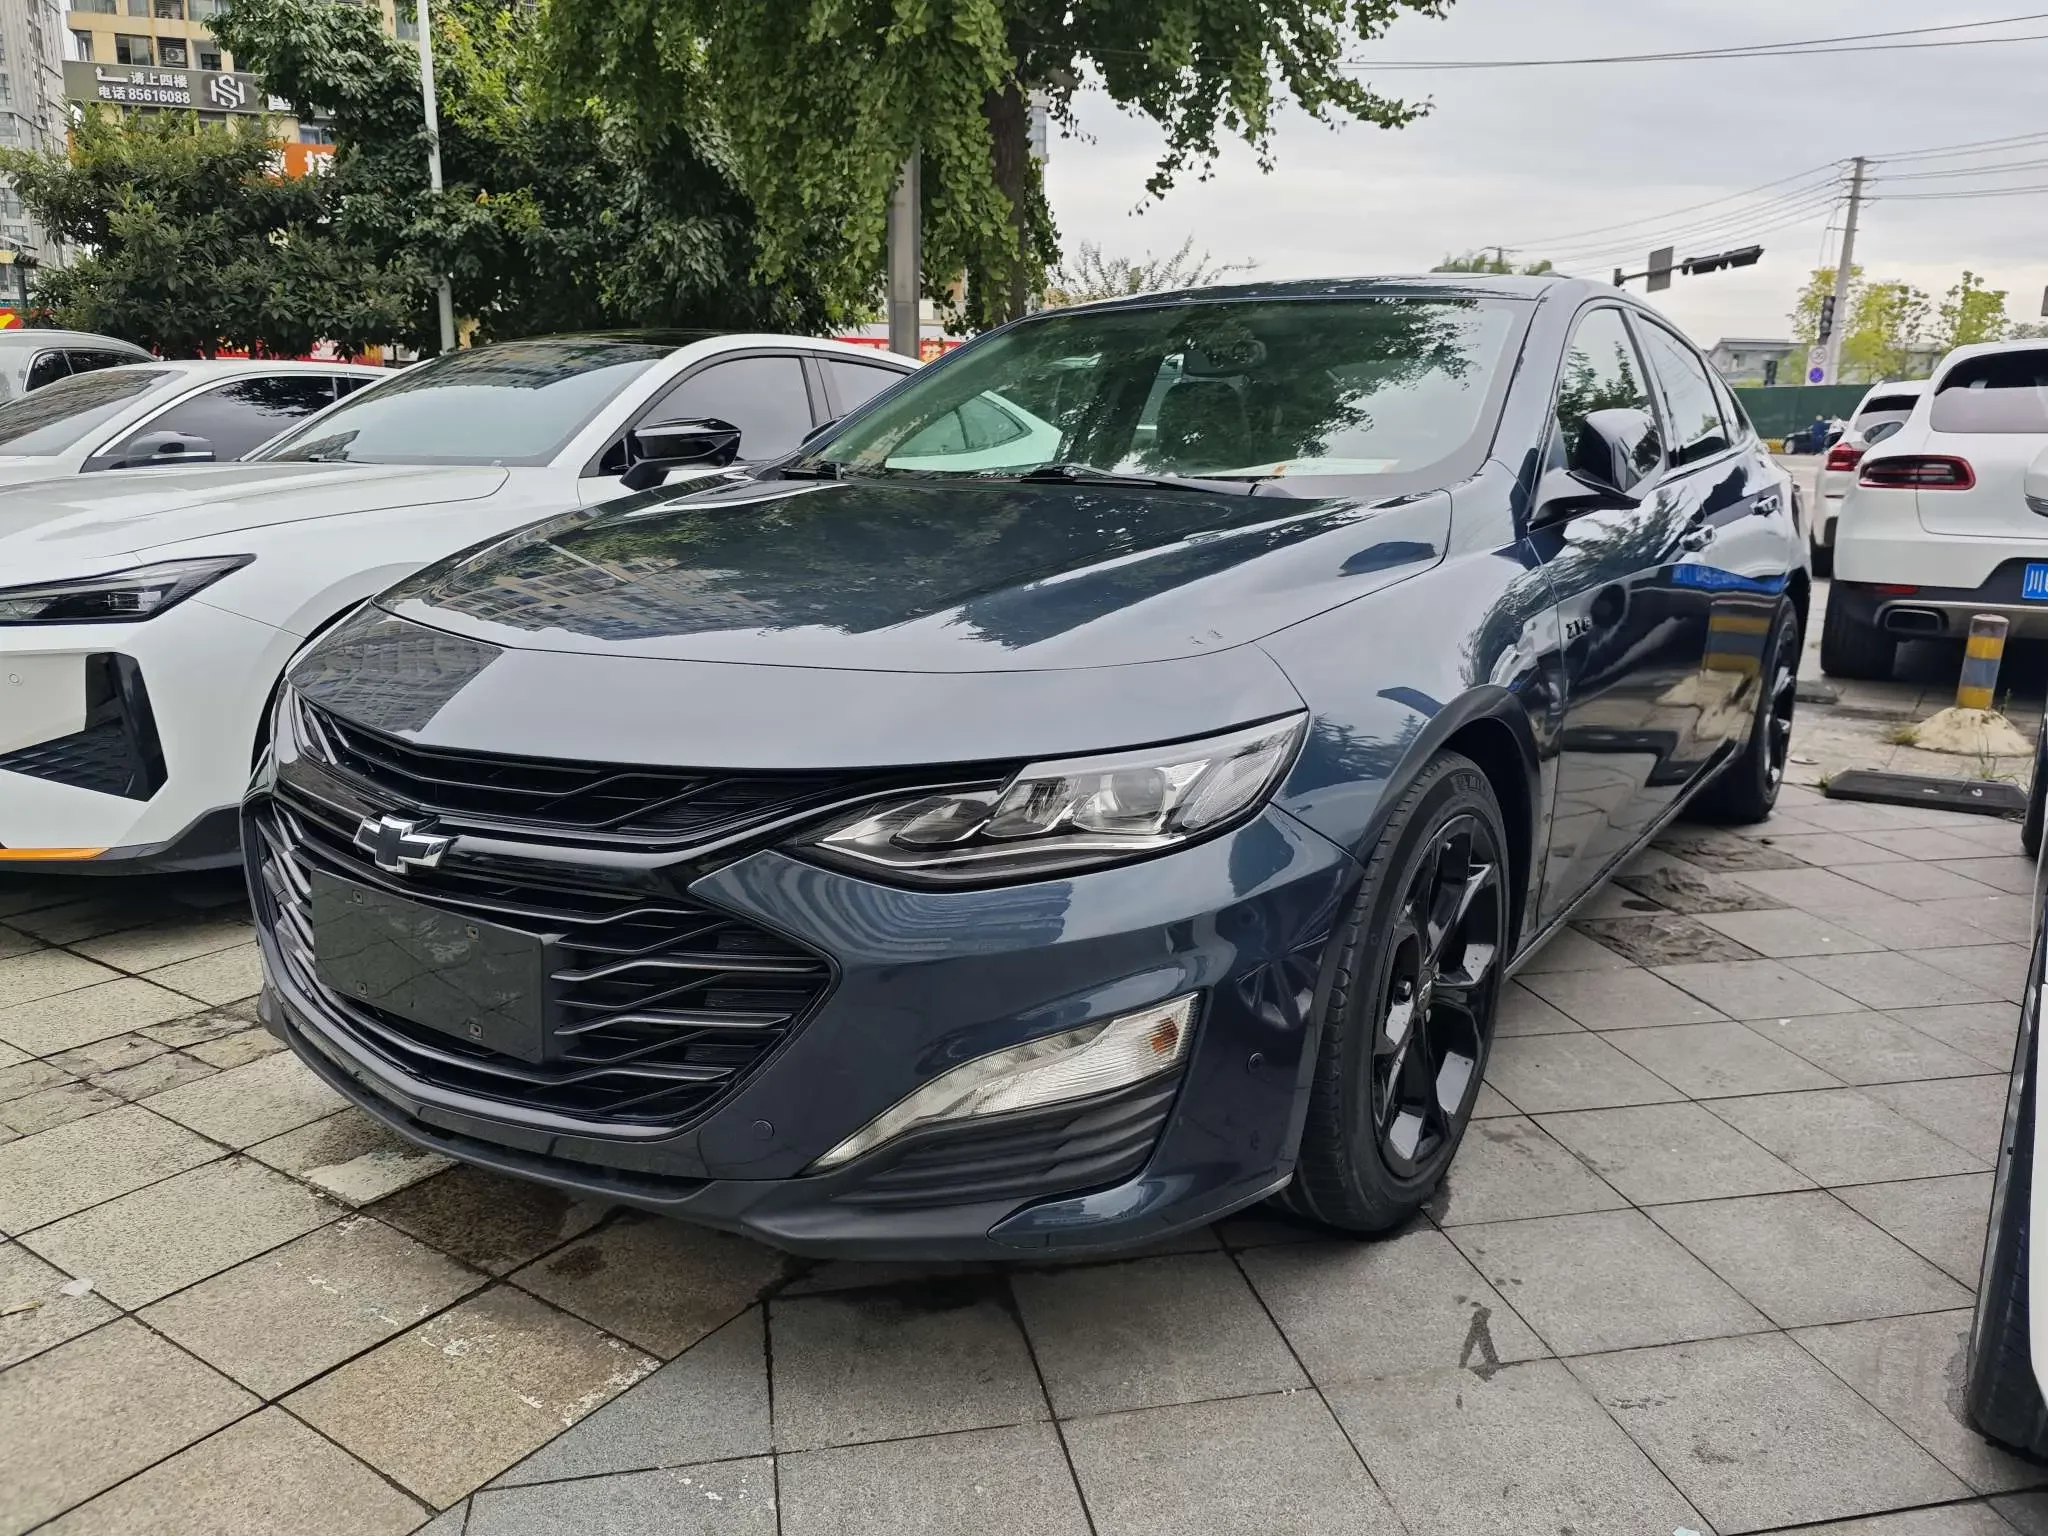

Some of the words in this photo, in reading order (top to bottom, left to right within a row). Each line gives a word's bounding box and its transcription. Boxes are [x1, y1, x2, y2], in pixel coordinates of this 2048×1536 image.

[130, 72, 188, 88] 请上四楼
[98, 86, 126, 100] 电话
[129, 89, 190, 104] 85616088
[2029, 570, 2048, 593] 川
